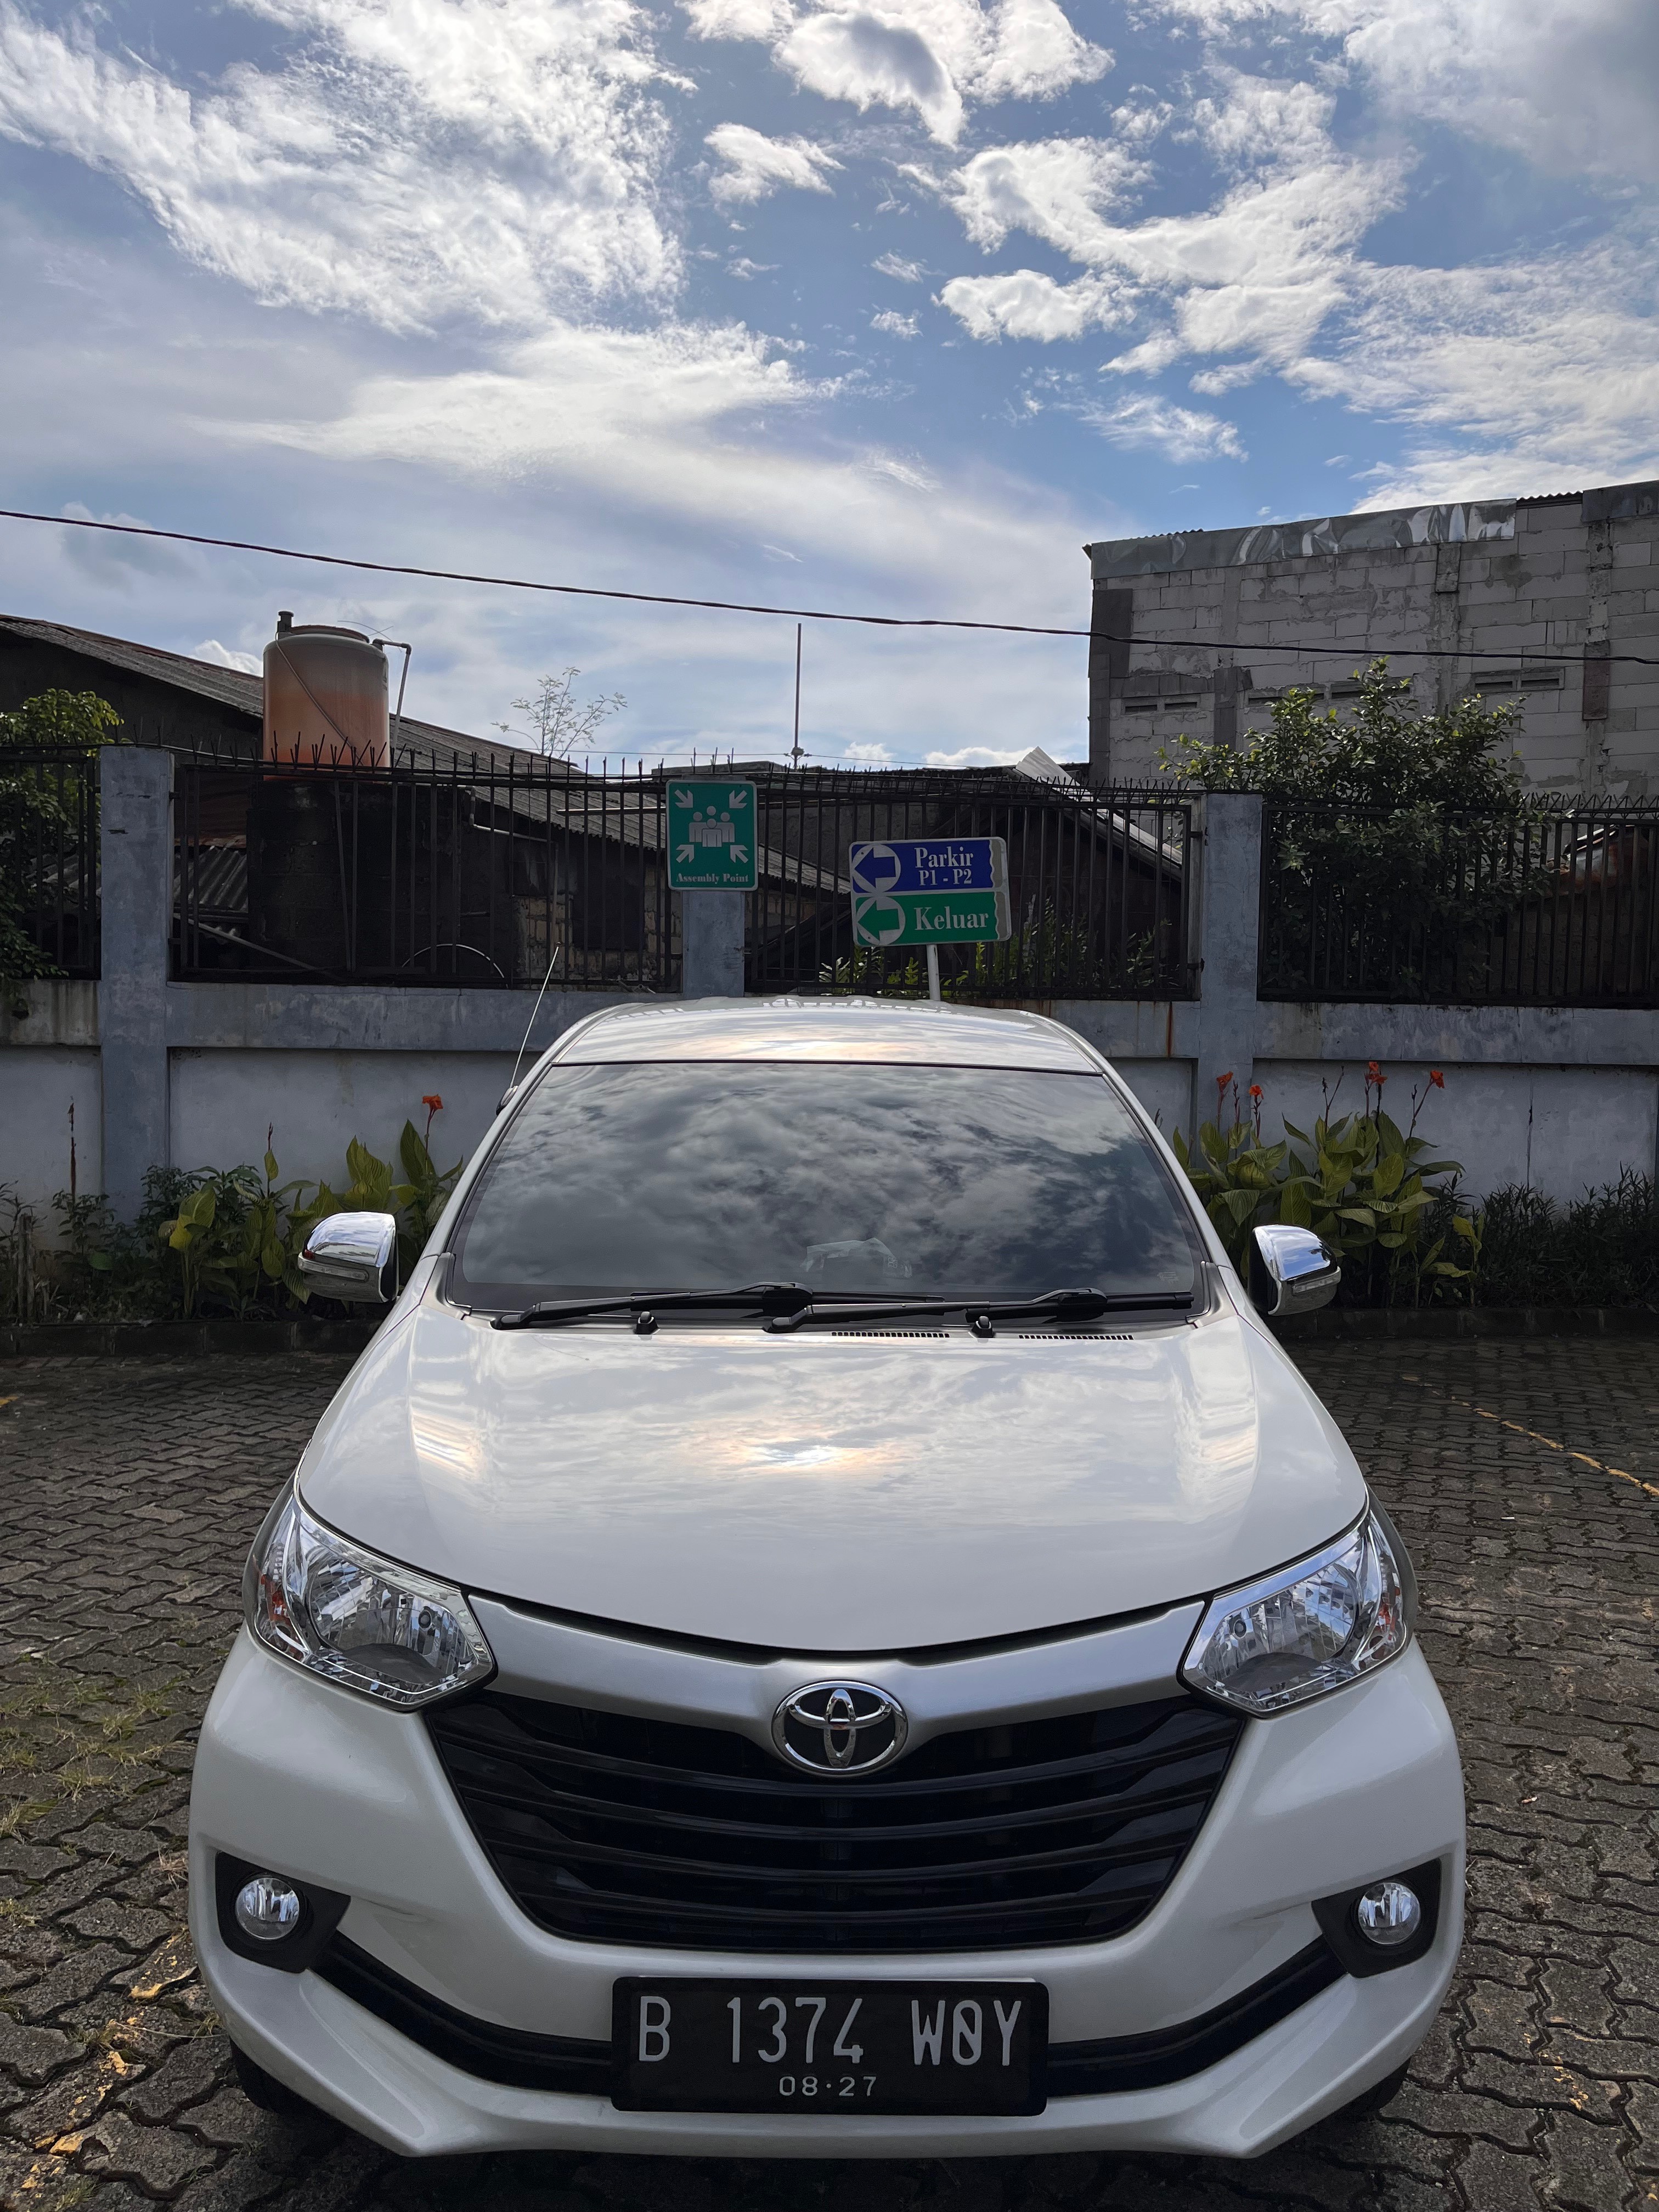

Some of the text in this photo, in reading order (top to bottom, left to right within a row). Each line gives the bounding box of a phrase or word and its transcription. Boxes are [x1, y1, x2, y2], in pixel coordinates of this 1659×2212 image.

[914, 846, 974, 868] Parkir
[676, 873, 749, 884] Assembly Point
[918, 870, 938, 886] P1
[952, 868, 972, 884] P2
[913, 906, 989, 930] Keluar
[639, 1995, 672, 2063] B
[727, 1996, 864, 2064] 1374
